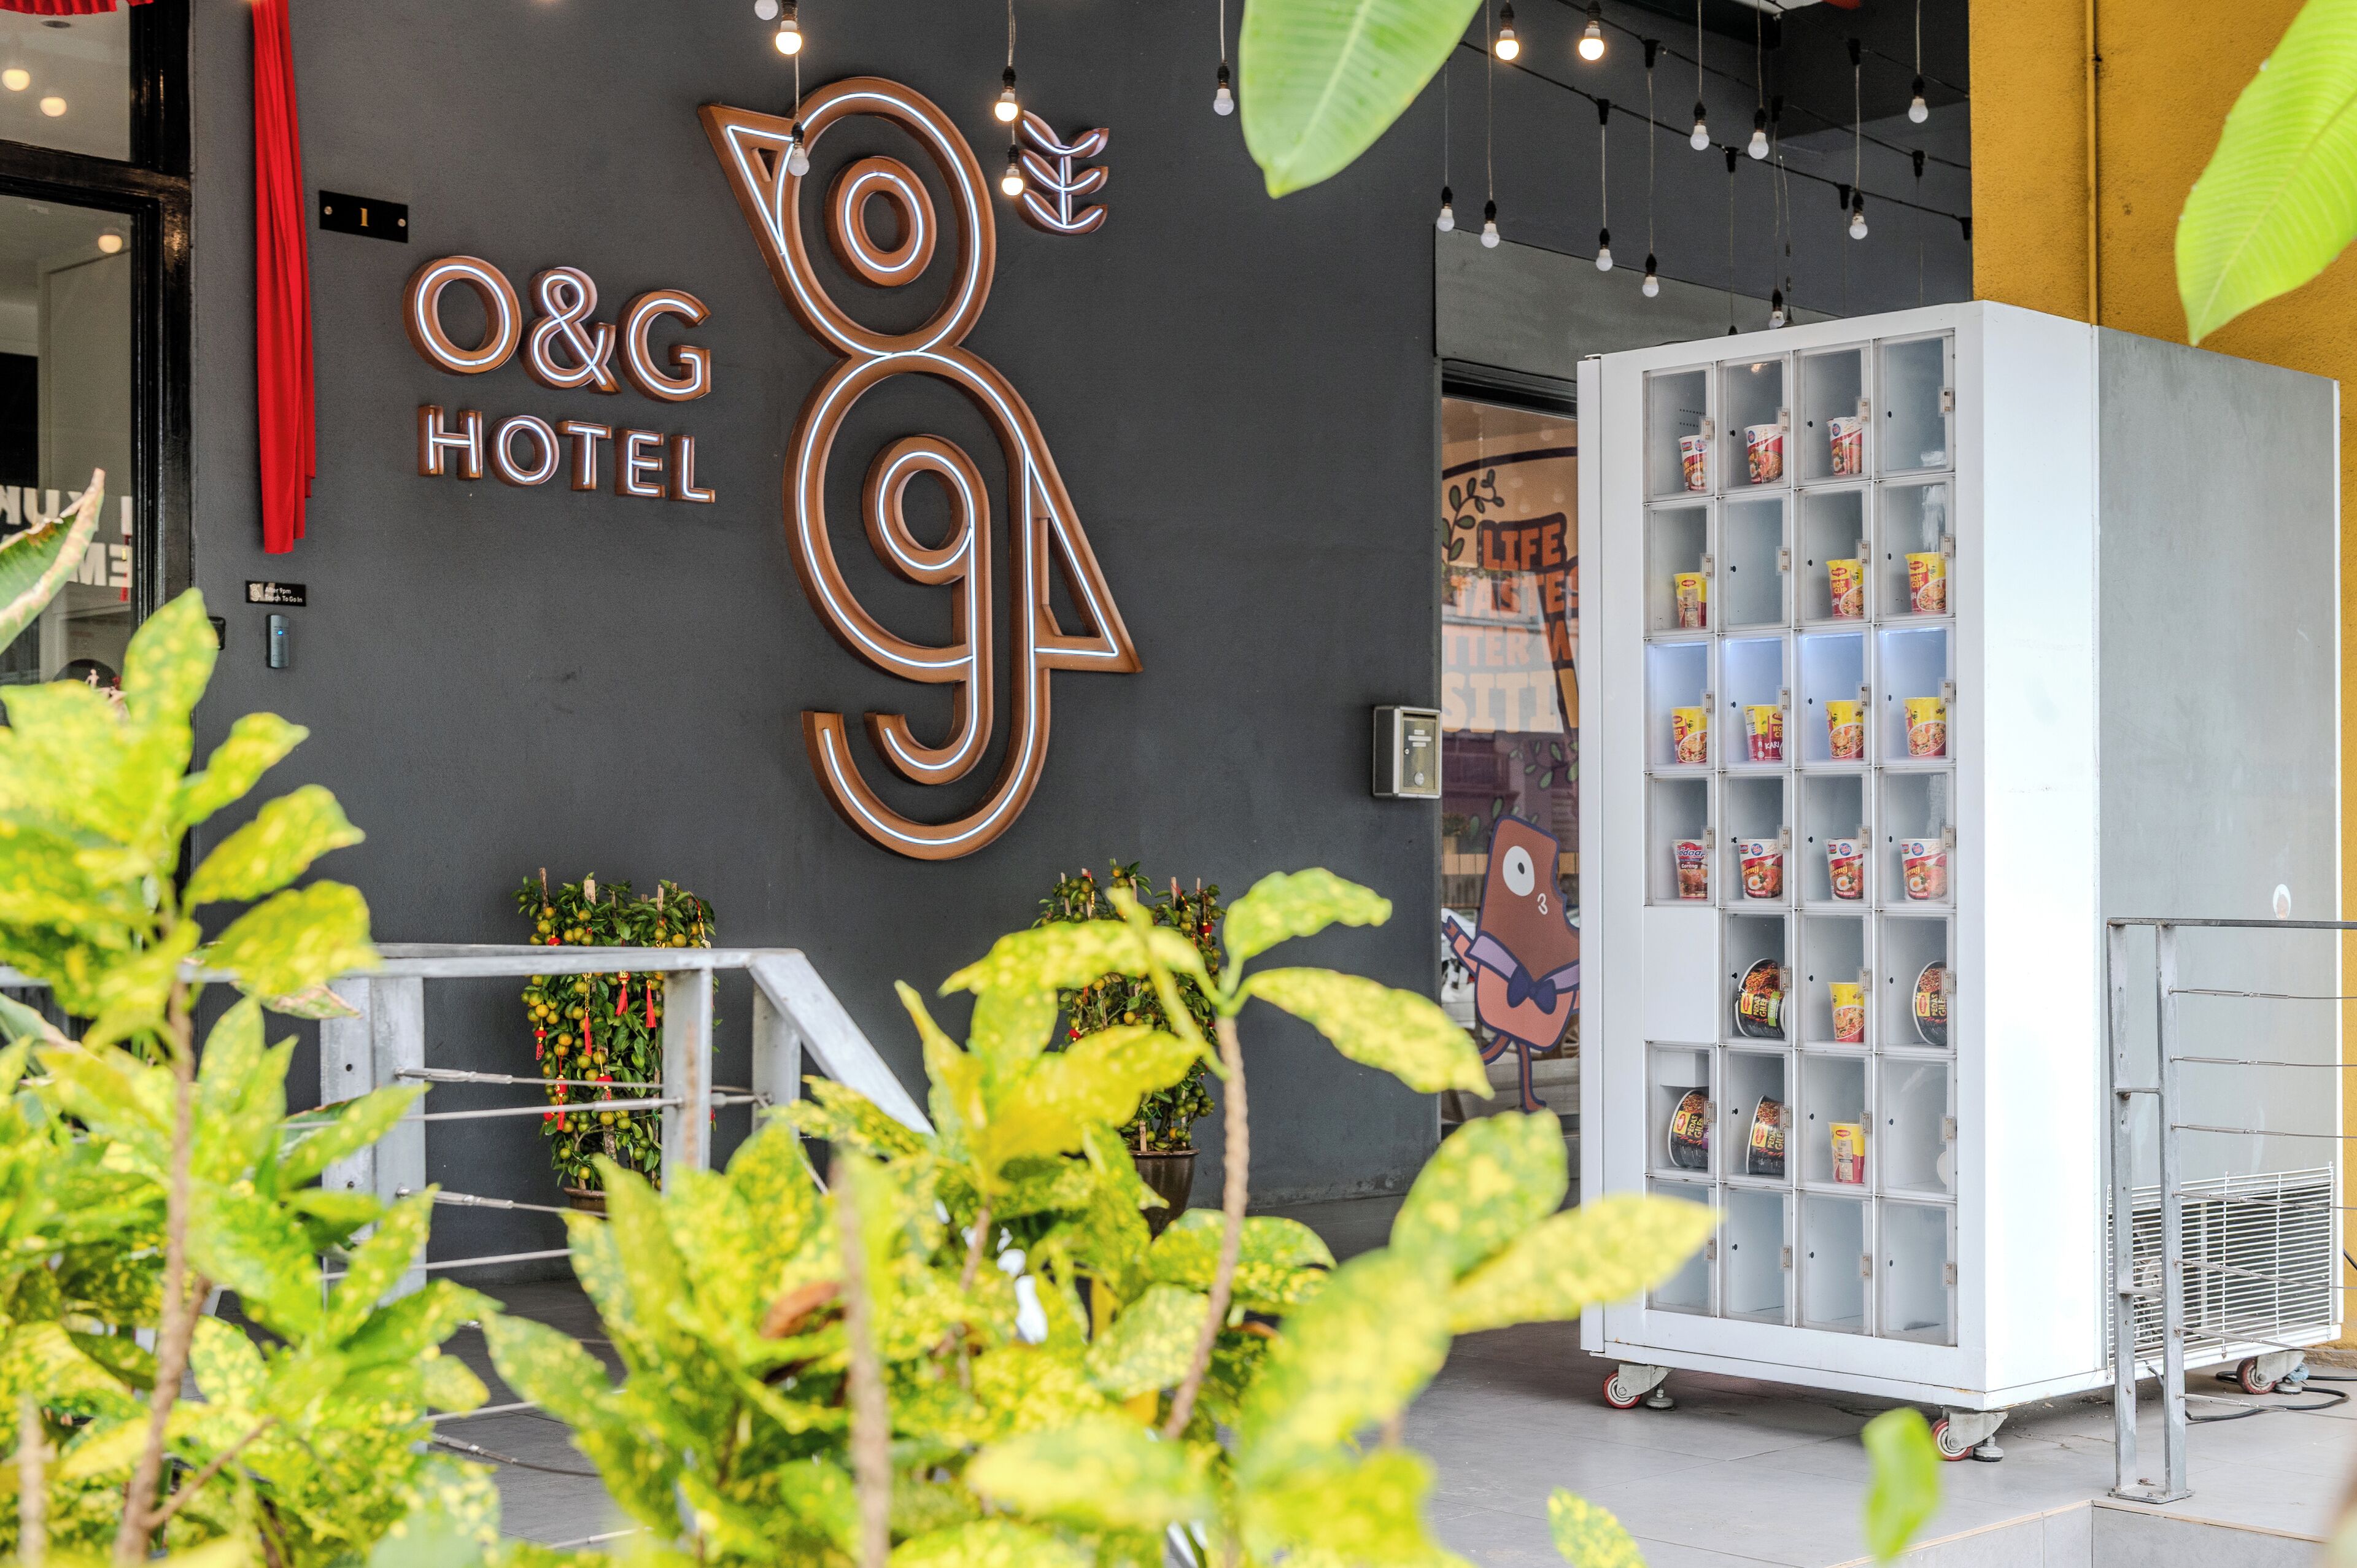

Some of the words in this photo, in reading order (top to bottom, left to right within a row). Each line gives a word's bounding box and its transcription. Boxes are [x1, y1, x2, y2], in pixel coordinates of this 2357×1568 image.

[403, 255, 711, 403] O&G
[418, 404, 715, 503] HOTEL
[1483, 522, 1562, 571] LIFE
[1765, 741, 1780, 750] KARI
[1687, 1115, 1698, 1136] PEDAS
